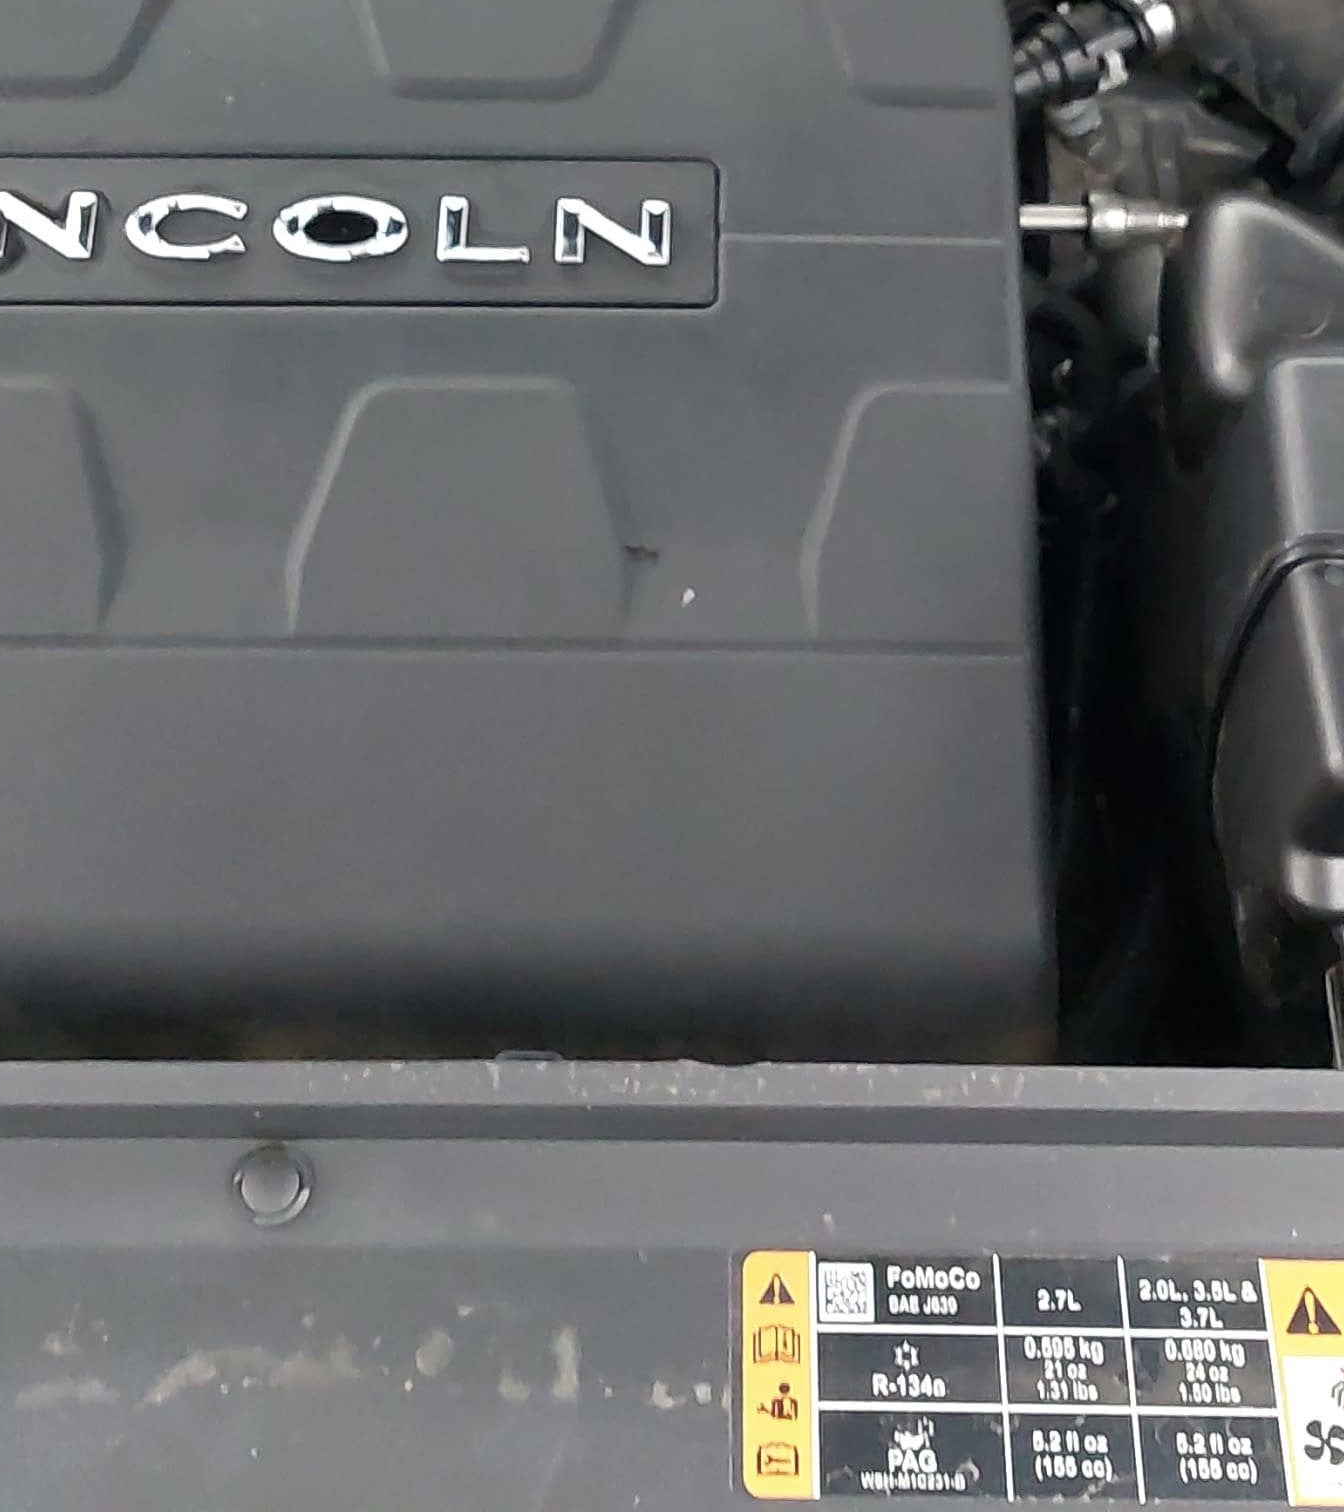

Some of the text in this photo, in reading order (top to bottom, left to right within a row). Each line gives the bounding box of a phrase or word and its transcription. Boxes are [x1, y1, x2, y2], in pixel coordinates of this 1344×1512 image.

[886, 1265, 981, 1290] FoMoCo
[1037, 1288, 1082, 1311] 2.7L
[1179, 1306, 1224, 1328] 3.7L
[1079, 1336, 1104, 1366] kg
[1219, 1340, 1245, 1367] kg
[872, 1373, 946, 1397] R-134a
[1084, 1434, 1109, 1454] oz
[1228, 1436, 1253, 1456] oz
[888, 1448, 938, 1473] PAG
